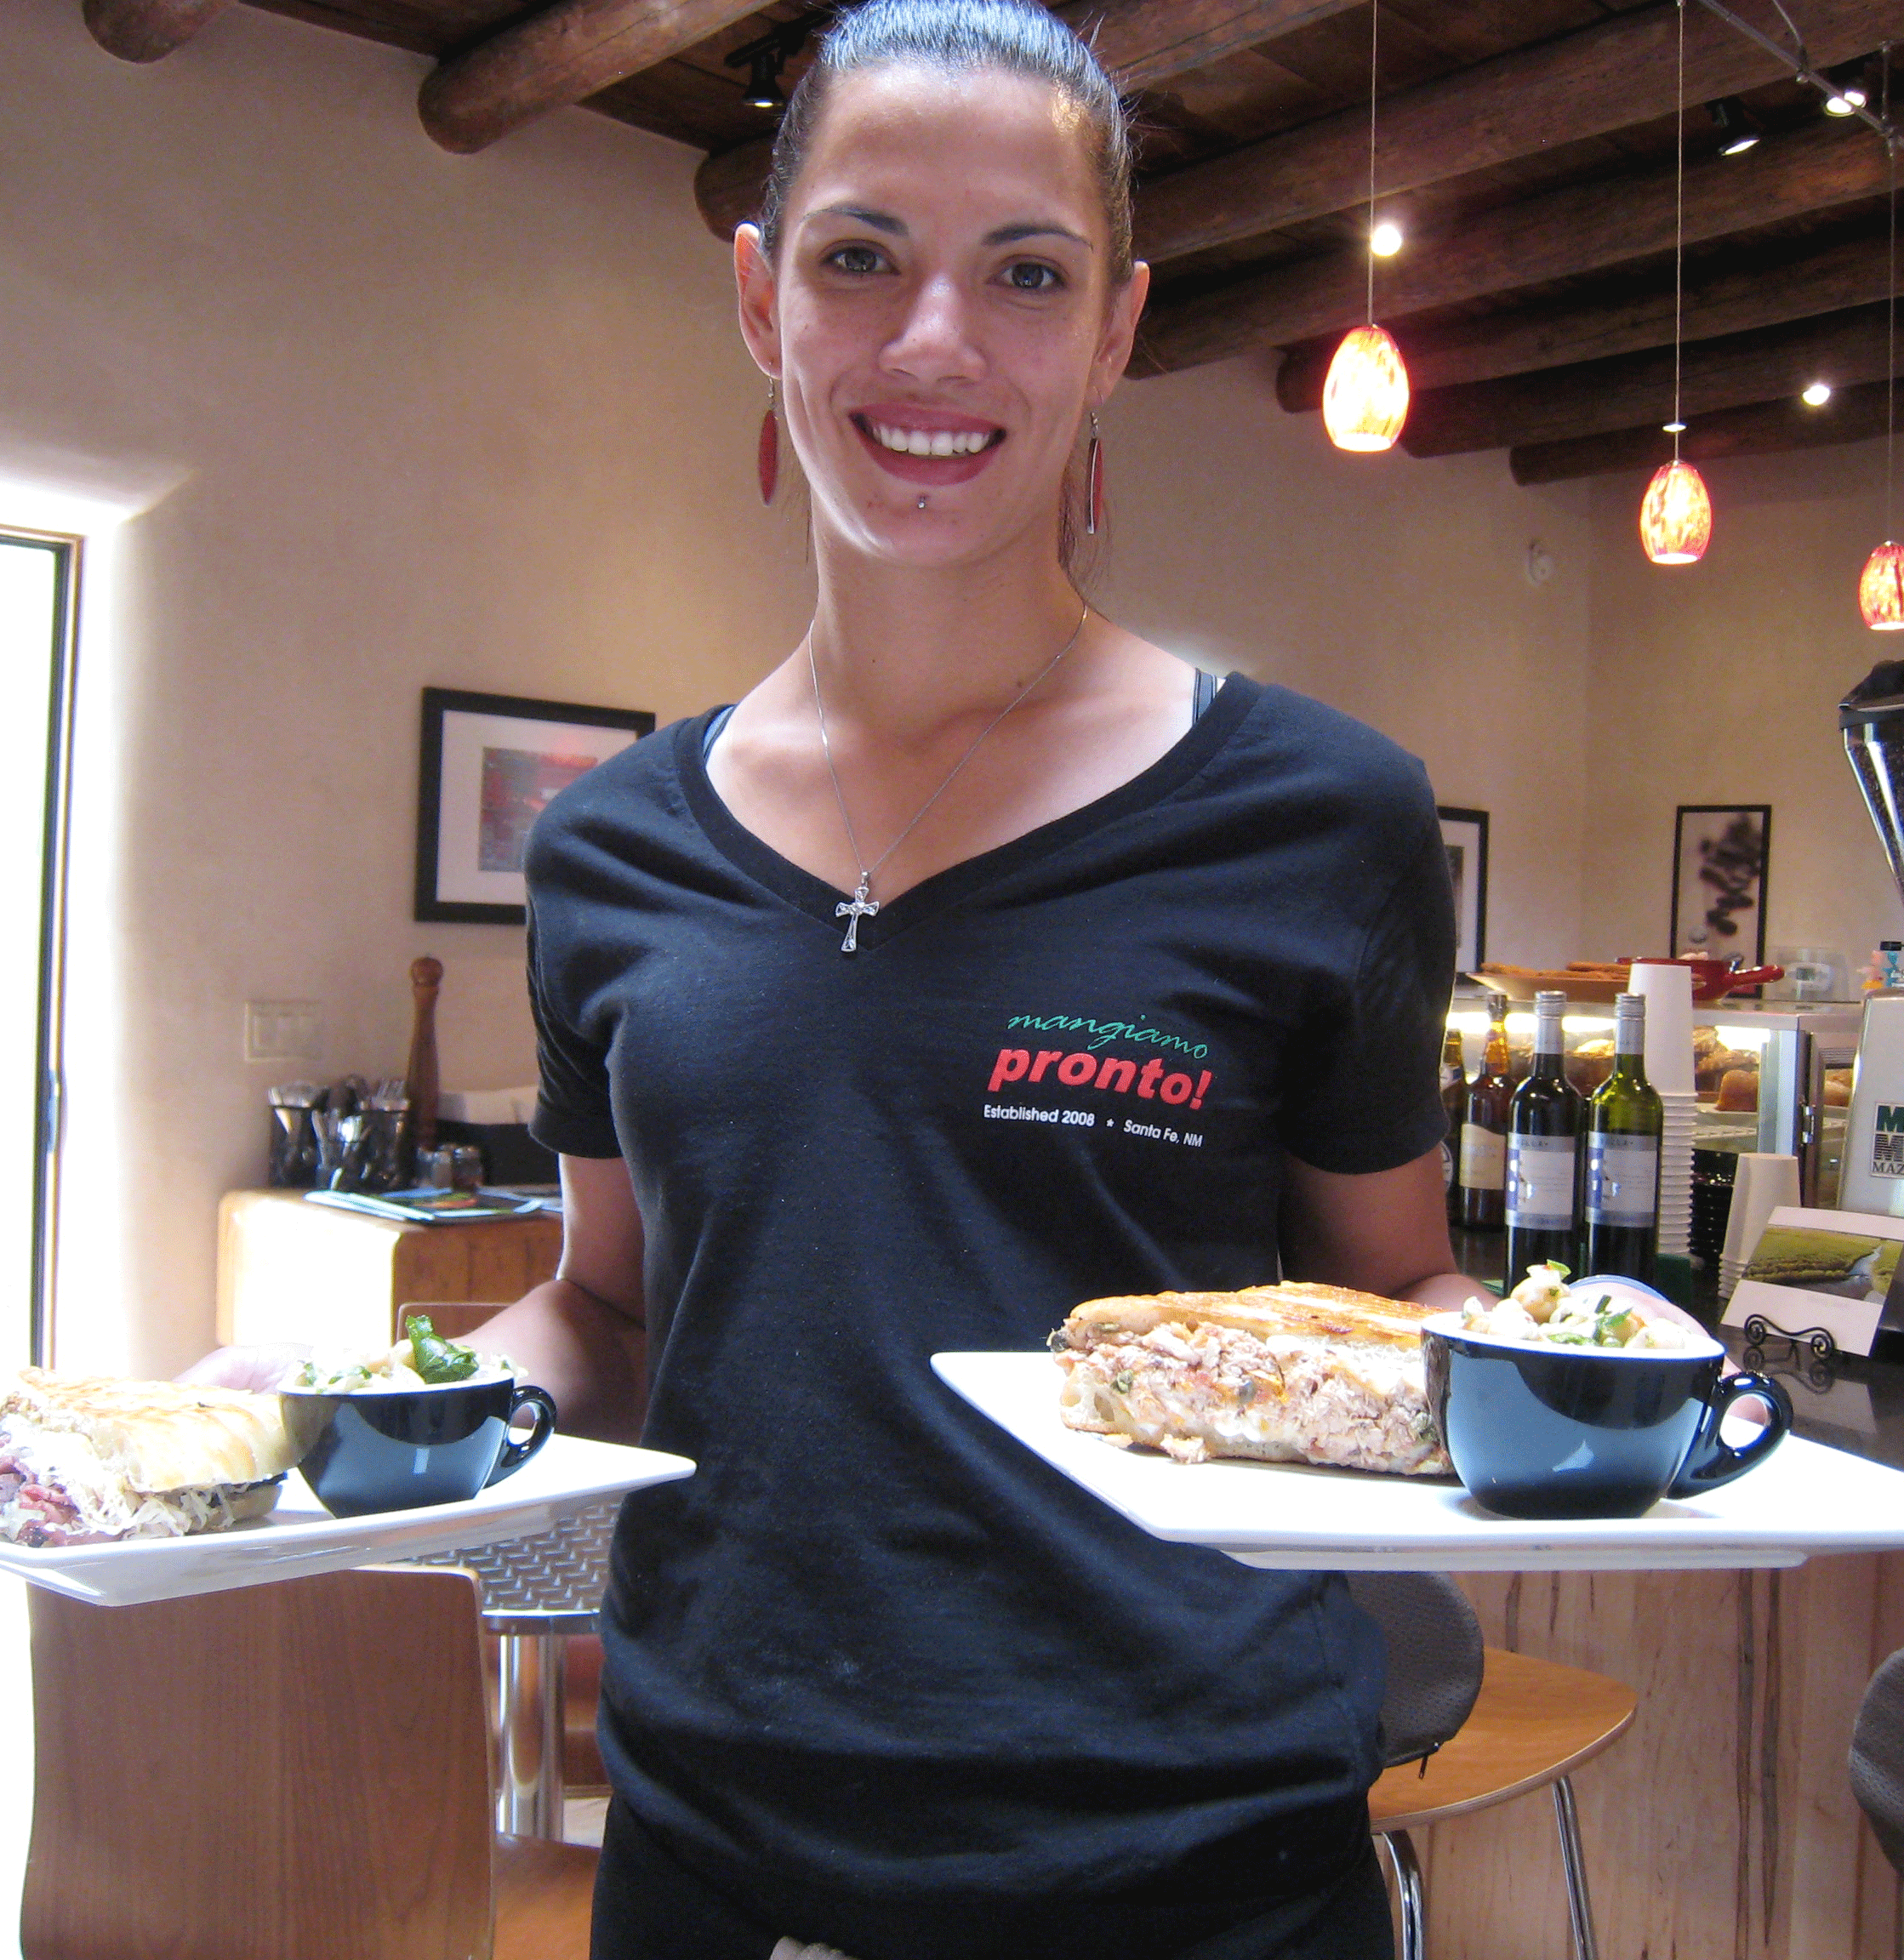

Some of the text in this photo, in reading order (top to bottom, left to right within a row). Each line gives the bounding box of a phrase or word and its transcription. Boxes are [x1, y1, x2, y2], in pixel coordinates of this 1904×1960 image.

[1007, 1013, 1208, 1059] mangiamo
[987, 1048, 1213, 1110] pronto!
[983, 1104, 1204, 1148] Established 2008 Santa Fe, NM
